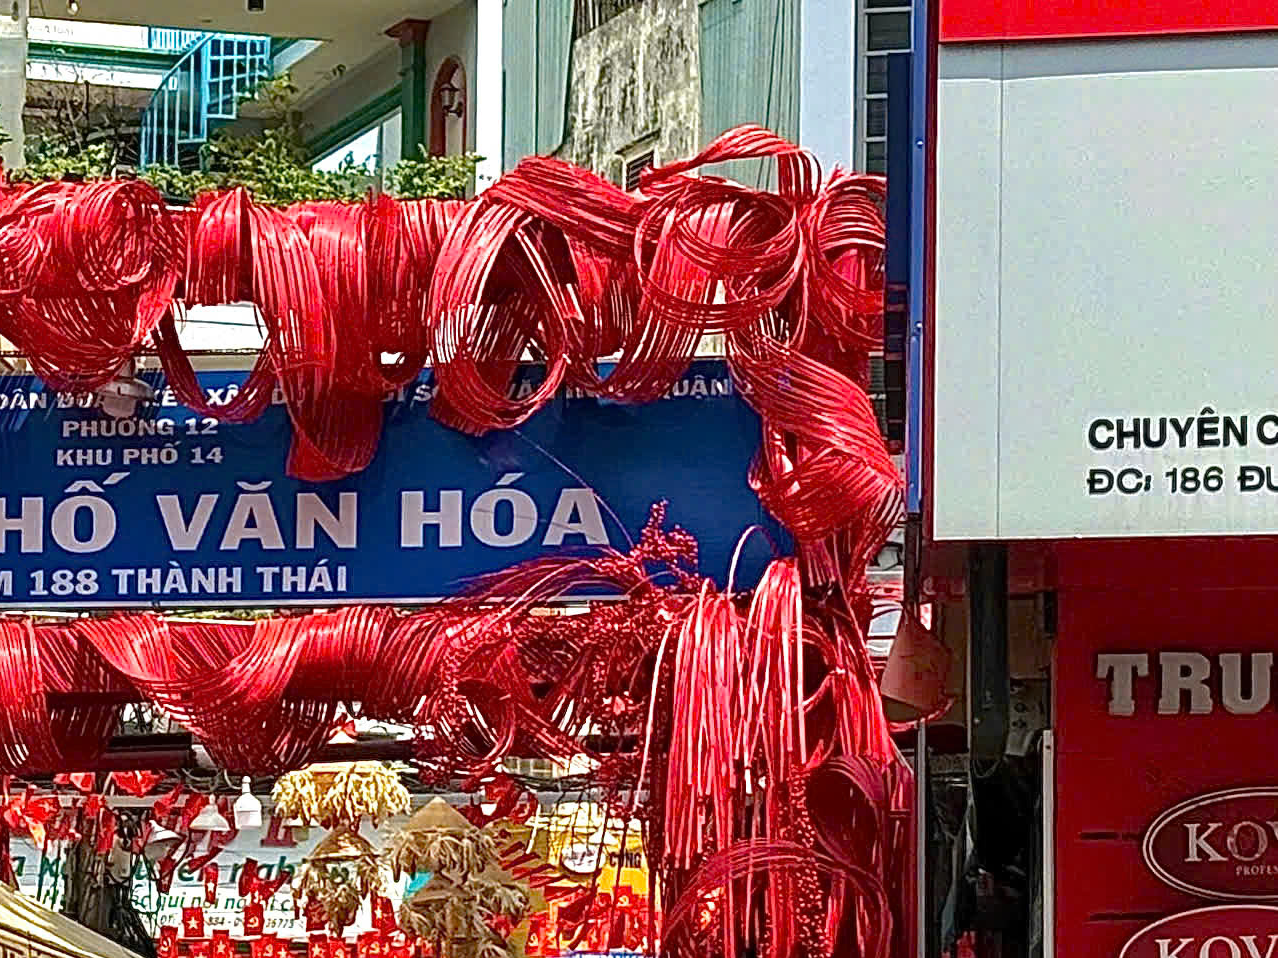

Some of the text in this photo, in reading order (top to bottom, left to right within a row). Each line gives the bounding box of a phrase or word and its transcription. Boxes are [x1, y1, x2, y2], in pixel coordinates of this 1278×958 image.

[185, 417, 219, 436] 12
[1087, 406, 1248, 450] CHUYÊN
[56, 440, 223, 467] KHU PHỐ 14
[1165, 465, 1224, 494] 186
[156, 480, 358, 552] VĂN
[400, 472, 610, 548] HÓA
[29, 568, 99, 597] 188
[111, 559, 242, 596] THÀNH
[256, 558, 348, 594] THÁI
